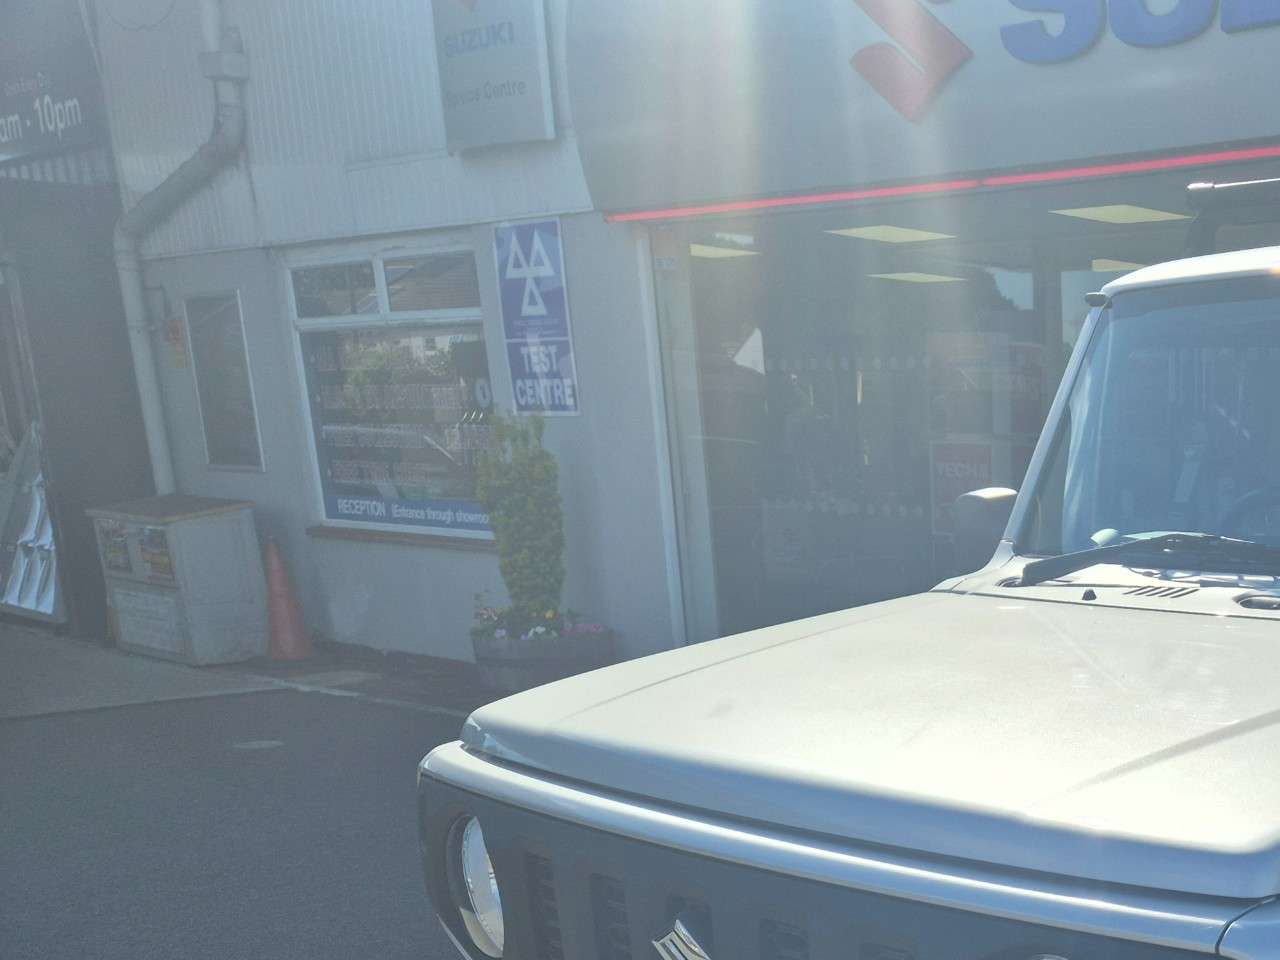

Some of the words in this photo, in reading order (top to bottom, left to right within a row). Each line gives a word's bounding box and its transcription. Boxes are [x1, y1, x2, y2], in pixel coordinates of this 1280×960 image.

[443, 21, 514, 58] SUZUKI
[482, 79, 527, 99] Centre
[33, 94, 82, 141] 10pm
[520, 345, 557, 374] TEST
[515, 378, 574, 407] CENTRE
[336, 499, 386, 517] RECEPTION
[426, 508, 455, 524] through
